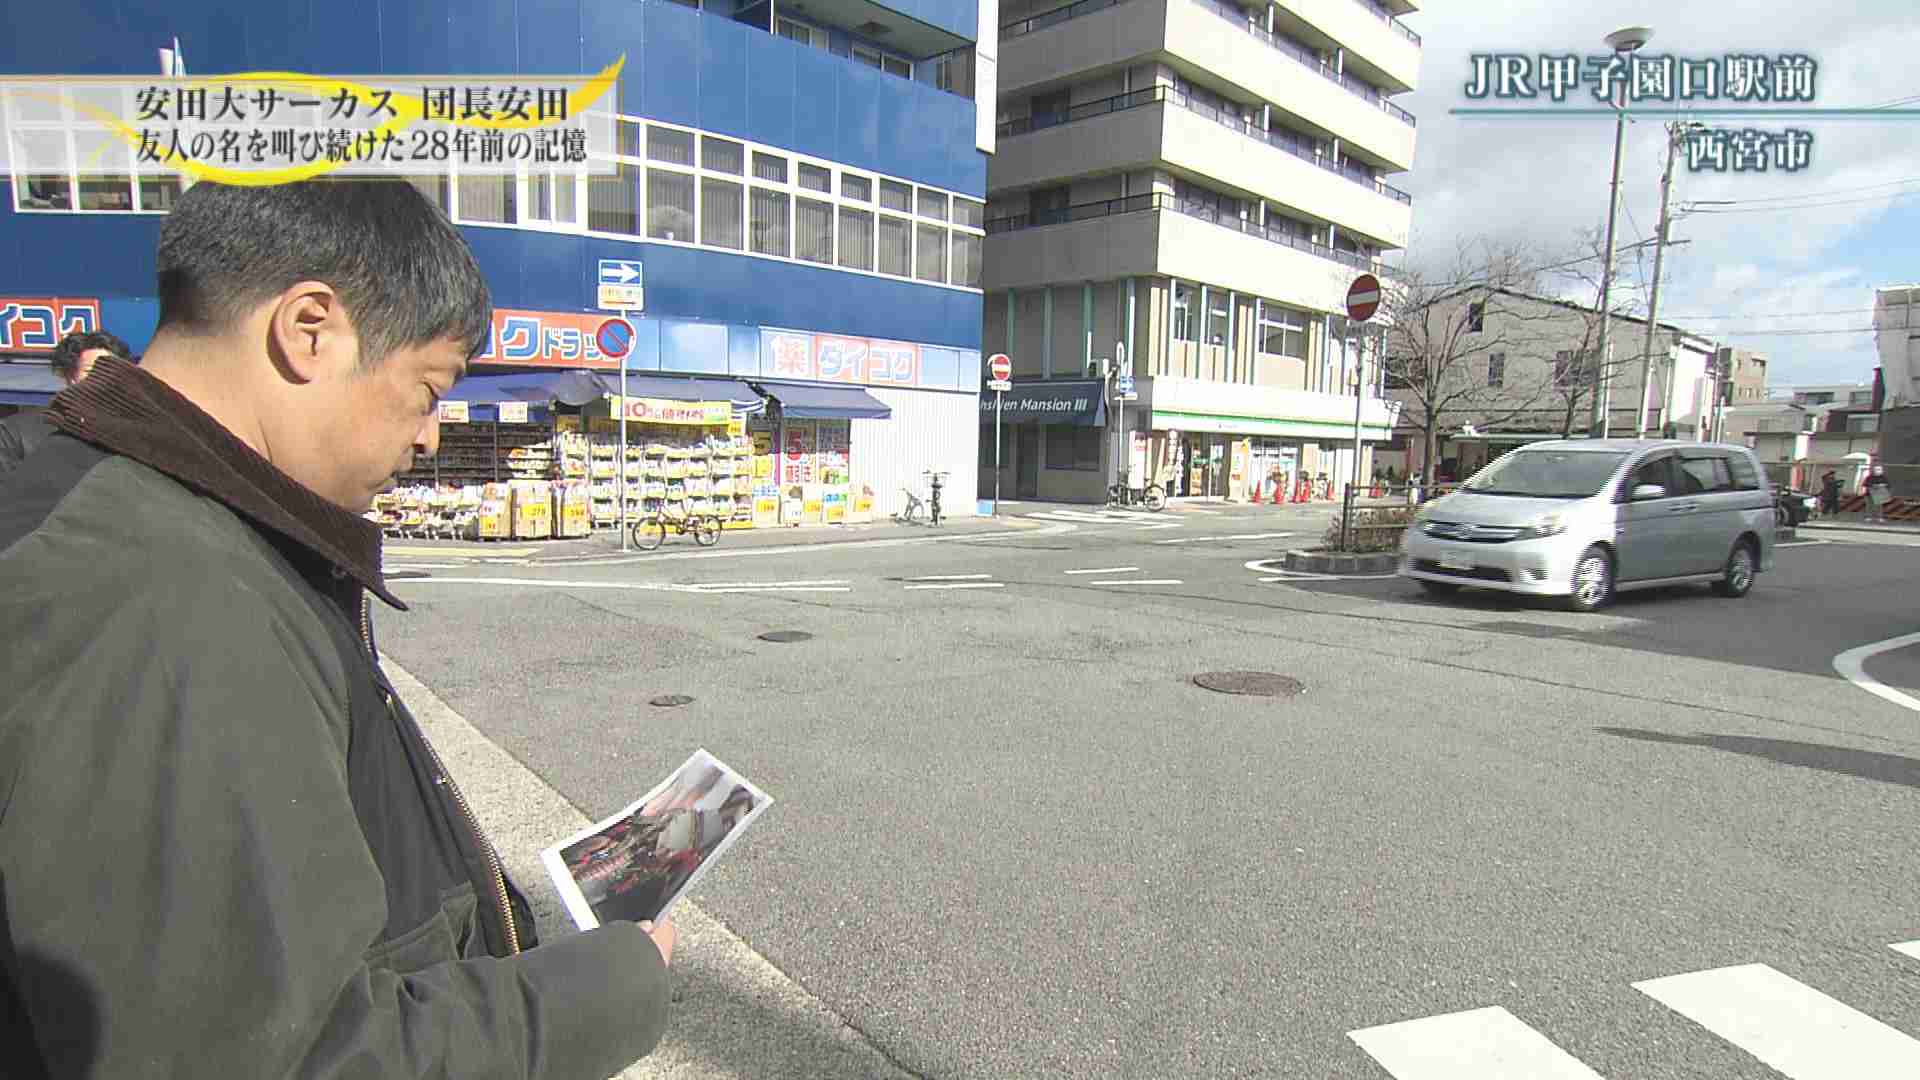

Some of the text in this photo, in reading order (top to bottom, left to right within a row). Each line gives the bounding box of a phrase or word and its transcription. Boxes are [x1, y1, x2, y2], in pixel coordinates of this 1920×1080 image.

[819, 340, 914, 385] ダイコク
[1020, 398, 1072, 411] Mansion
